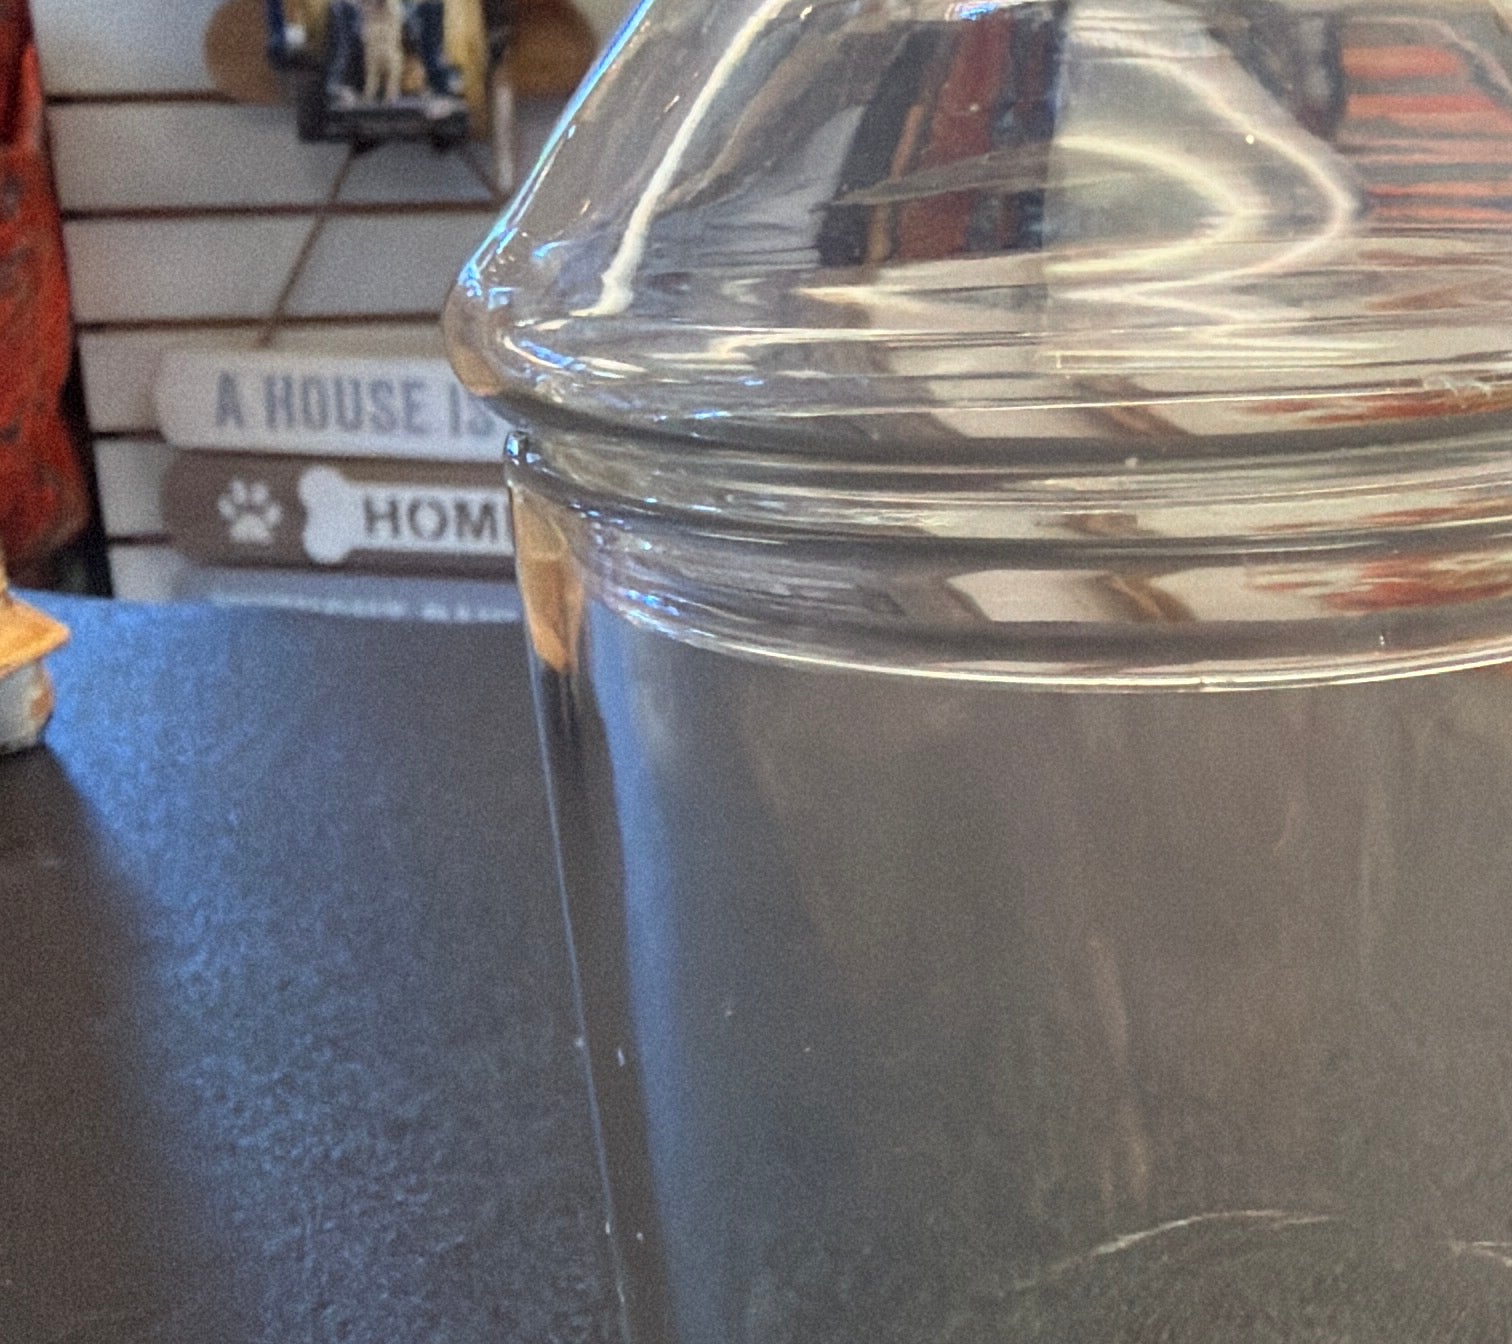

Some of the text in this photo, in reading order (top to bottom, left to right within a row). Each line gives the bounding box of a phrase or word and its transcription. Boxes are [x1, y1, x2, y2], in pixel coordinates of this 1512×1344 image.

[212, 370, 242, 431] A
[264, 372, 429, 438] HOUSE
[362, 495, 512, 543] HOM
